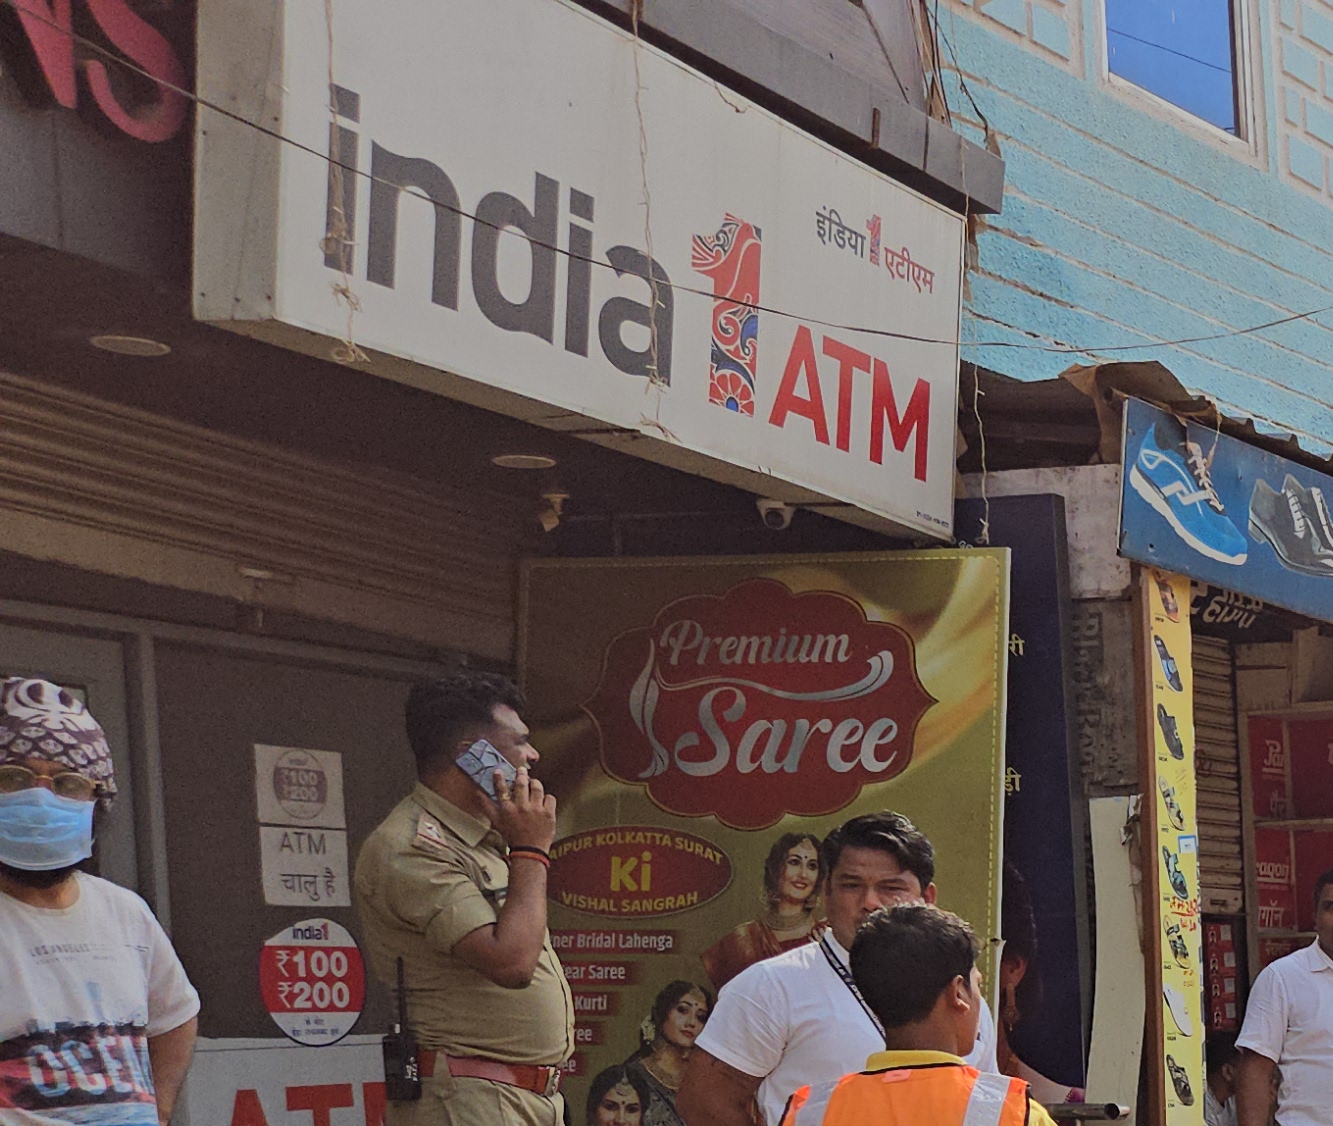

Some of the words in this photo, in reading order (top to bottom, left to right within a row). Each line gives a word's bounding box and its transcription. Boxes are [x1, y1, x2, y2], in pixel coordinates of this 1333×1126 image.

[884, 247, 935, 294] एटीएम
[769, 326, 931, 483] ATM
[659, 619, 854, 668] Premium
[674, 686, 898, 779] Saree
[280, 831, 327, 855] ATM
[548, 837, 593, 861] AIPUR
[595, 831, 672, 848] KOLKATTA
[675, 837, 723, 865] SURAT
[323, 867, 336, 897] है
[610, 851, 652, 892] Ki
[561, 891, 617, 911] VISHAL
[621, 891, 698, 912] SANGRAH
[577, 932, 615, 949] Bridal
[618, 933, 673, 951] Lahenga
[275, 949, 348, 977] ₹100
[588, 964, 626, 979] Saree
[277, 981, 350, 1008] ₹200
[575, 994, 607, 1010] Kurti
